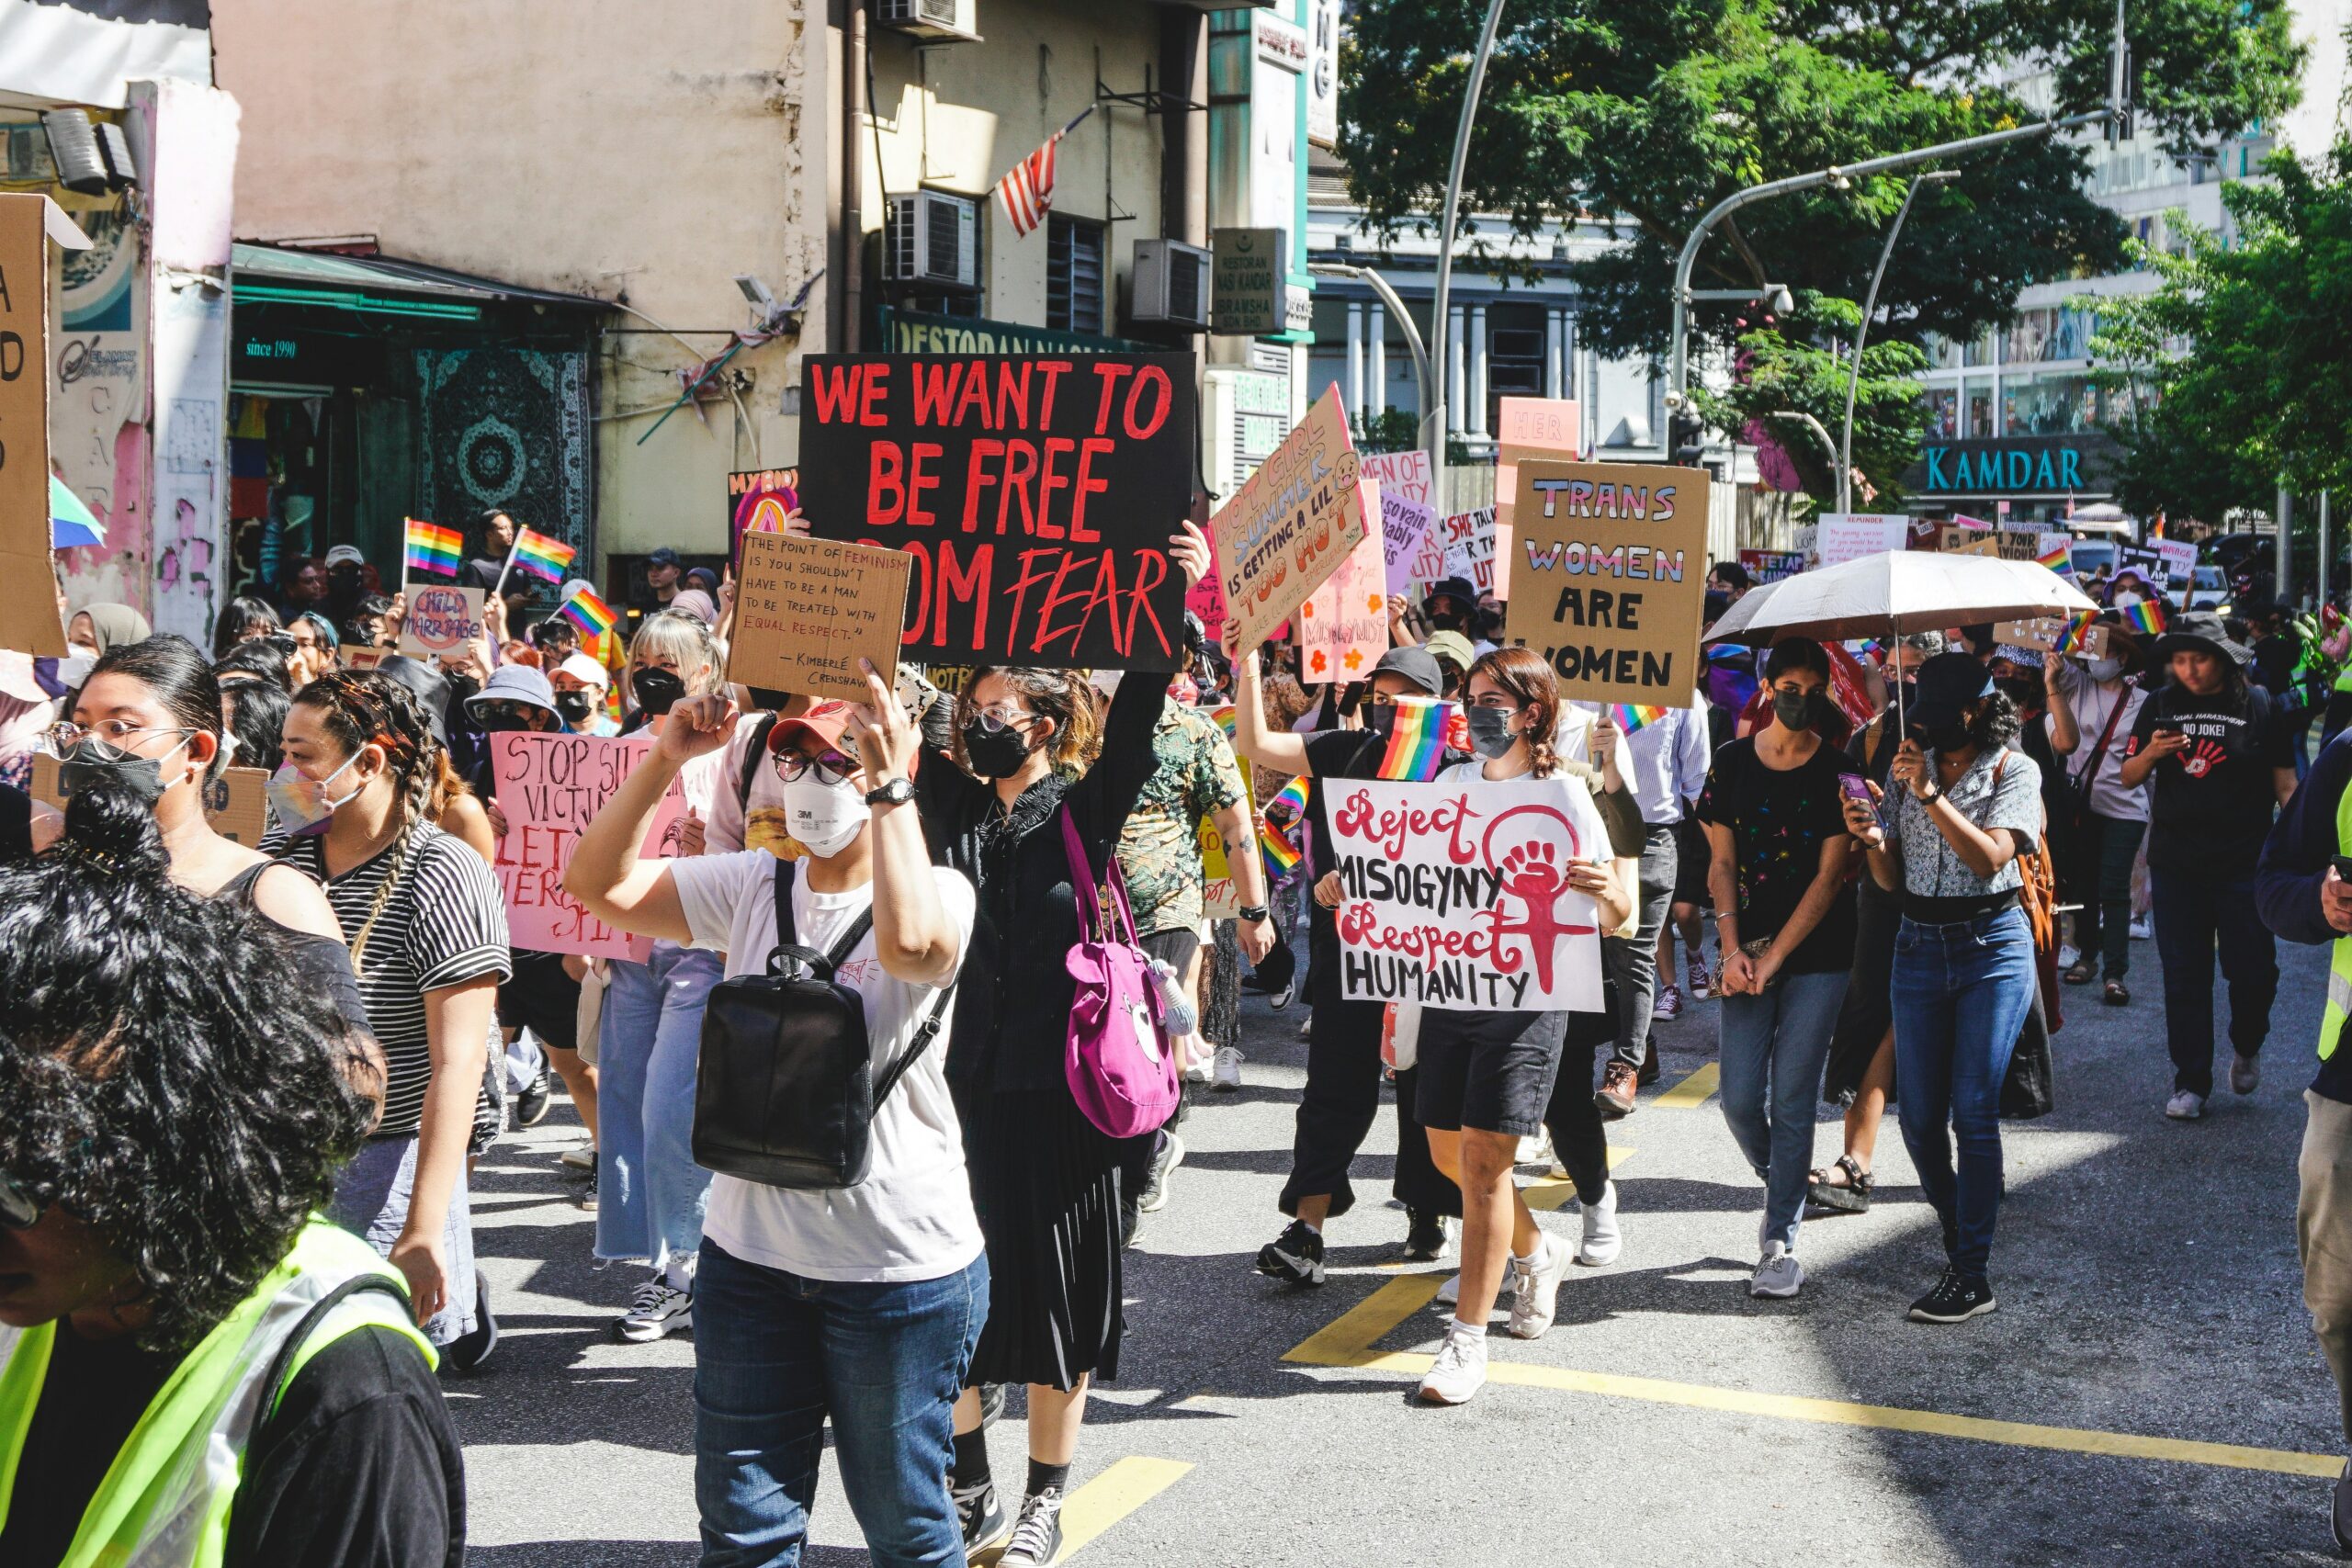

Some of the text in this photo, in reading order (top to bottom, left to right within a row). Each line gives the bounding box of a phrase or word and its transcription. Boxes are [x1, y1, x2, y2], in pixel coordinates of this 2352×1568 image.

[1221, 257, 1268, 269] RESTORAN
[1238, 272, 1272, 290] KANDAR
[245, 337, 296, 359] since 1990
[812, 361, 1172, 439] WE WANT TO
[1514, 412, 1562, 441] HER
[1215, 415, 1325, 547] HOT GIRL
[1400, 452, 1425, 480] OF
[1927, 446, 2084, 491] KAMDAR
[729, 471, 760, 495] MY
[867, 438, 1115, 543] BE FREE
[1234, 442, 1332, 566] SUMMER
[1532, 479, 1677, 522] TRANS
[1384, 500, 1400, 518] so
[1398, 508, 1427, 532] vain
[1448, 513, 1475, 543] SHE
[1227, 485, 1333, 598] IS GETTING A LIL
[1238, 556, 1287, 617] TOO
[1294, 492, 1351, 573] HOT
[2009, 532, 2035, 547] YOUR
[750, 556, 864, 581] IS YOU SHOULDN'T
[781, 540, 818, 555] POINT
[824, 548, 841, 558] OF
[845, 550, 907, 572] FEMINISM
[1525, 539, 1684, 582] WOMEN
[1758, 554, 1804, 570] TETAP
[414, 592, 467, 614] CHILD
[746, 579, 859, 599] HAVE TO BE A MAN
[1003, 548, 1171, 658] FEAR
[745, 597, 876, 622] TO BE TREATED WITH
[1554, 587, 1643, 629] ARE
[403, 615, 480, 638] MARRIAGE
[743, 615, 786, 633] EQUAL
[1305, 616, 1386, 646] MISOGYNIST
[808, 671, 867, 688] CRENSHAW
[2183, 724, 2225, 736] NO JOKE!
[2195, 713, 2246, 727] HARASSMENT
[505, 736, 589, 785] STOP
[797, 810, 812, 819] 3M
[1335, 788, 1484, 864] Reject
[1335, 852, 1504, 919] MISOGYNY
[1341, 898, 1523, 975] Respect
[1345, 951, 1531, 1008] HUMANITY
